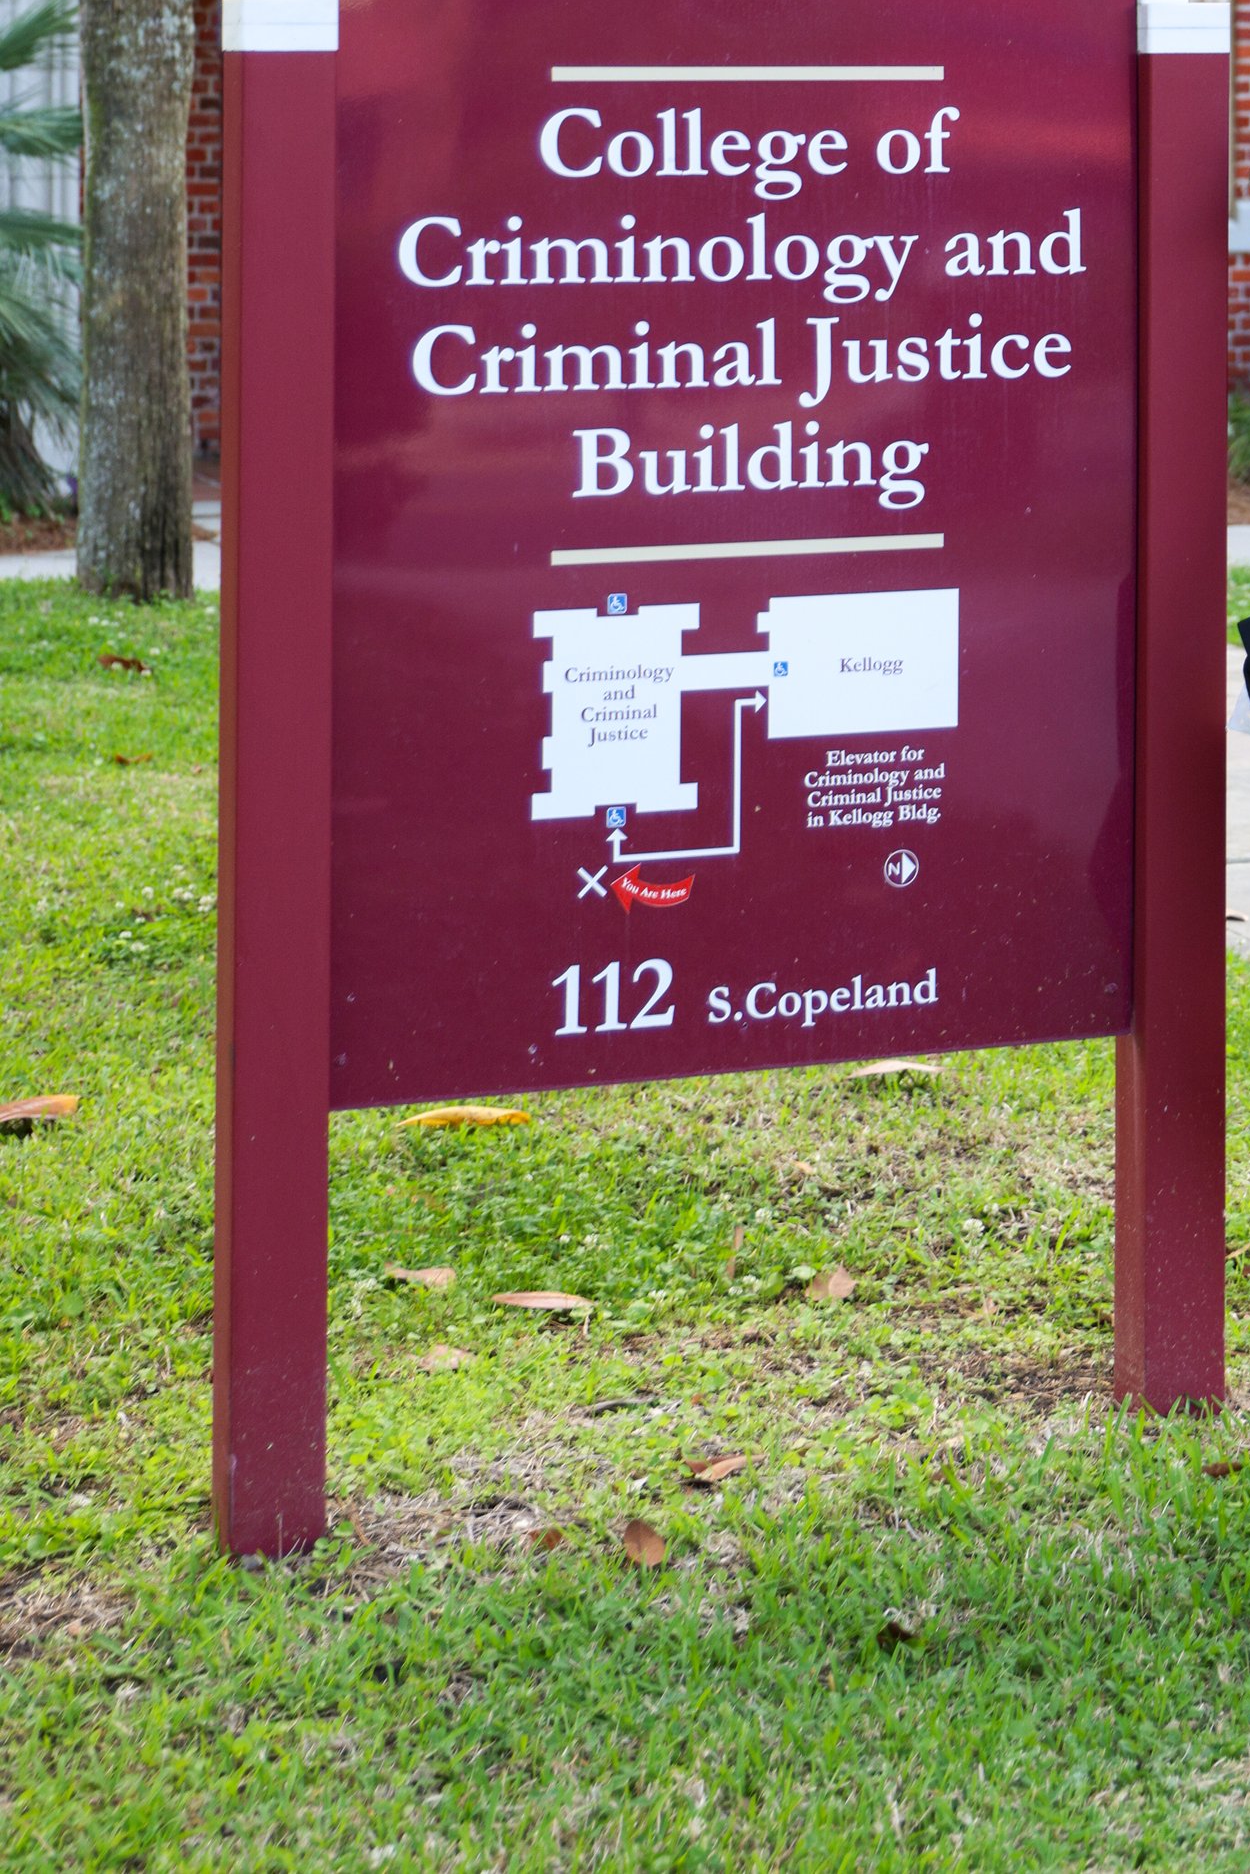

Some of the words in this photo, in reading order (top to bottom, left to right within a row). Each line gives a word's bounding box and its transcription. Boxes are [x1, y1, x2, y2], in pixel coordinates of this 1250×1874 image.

[540, 107, 848, 200] College
[876, 106, 960, 174] of
[398, 212, 919, 304] Criminology
[944, 208, 1087, 276] and
[412, 318, 783, 396] Criminal
[799, 313, 1072, 408] Justice
[572, 421, 930, 510] Building
[564, 664, 675, 683] Criminology
[840, 656, 904, 676] Kellogg
[603, 684, 635, 701] and
[581, 703, 657, 723] Criminal
[587, 725, 649, 748] Justice
[825, 749, 897, 767] Elevator
[900, 745, 925, 762] for
[804, 767, 910, 788] Criminology
[913, 763, 945, 781] and
[807, 787, 882, 808] Criminal
[884, 784, 942, 807] Justice
[806, 811, 824, 828] in
[827, 808, 894, 828] Kellogg
[898, 804, 942, 824] Bldg.
[621, 876, 640, 895] You
[640, 886, 659, 900] Are
[660, 887, 687, 900] Here
[551, 958, 675, 1036] 112
